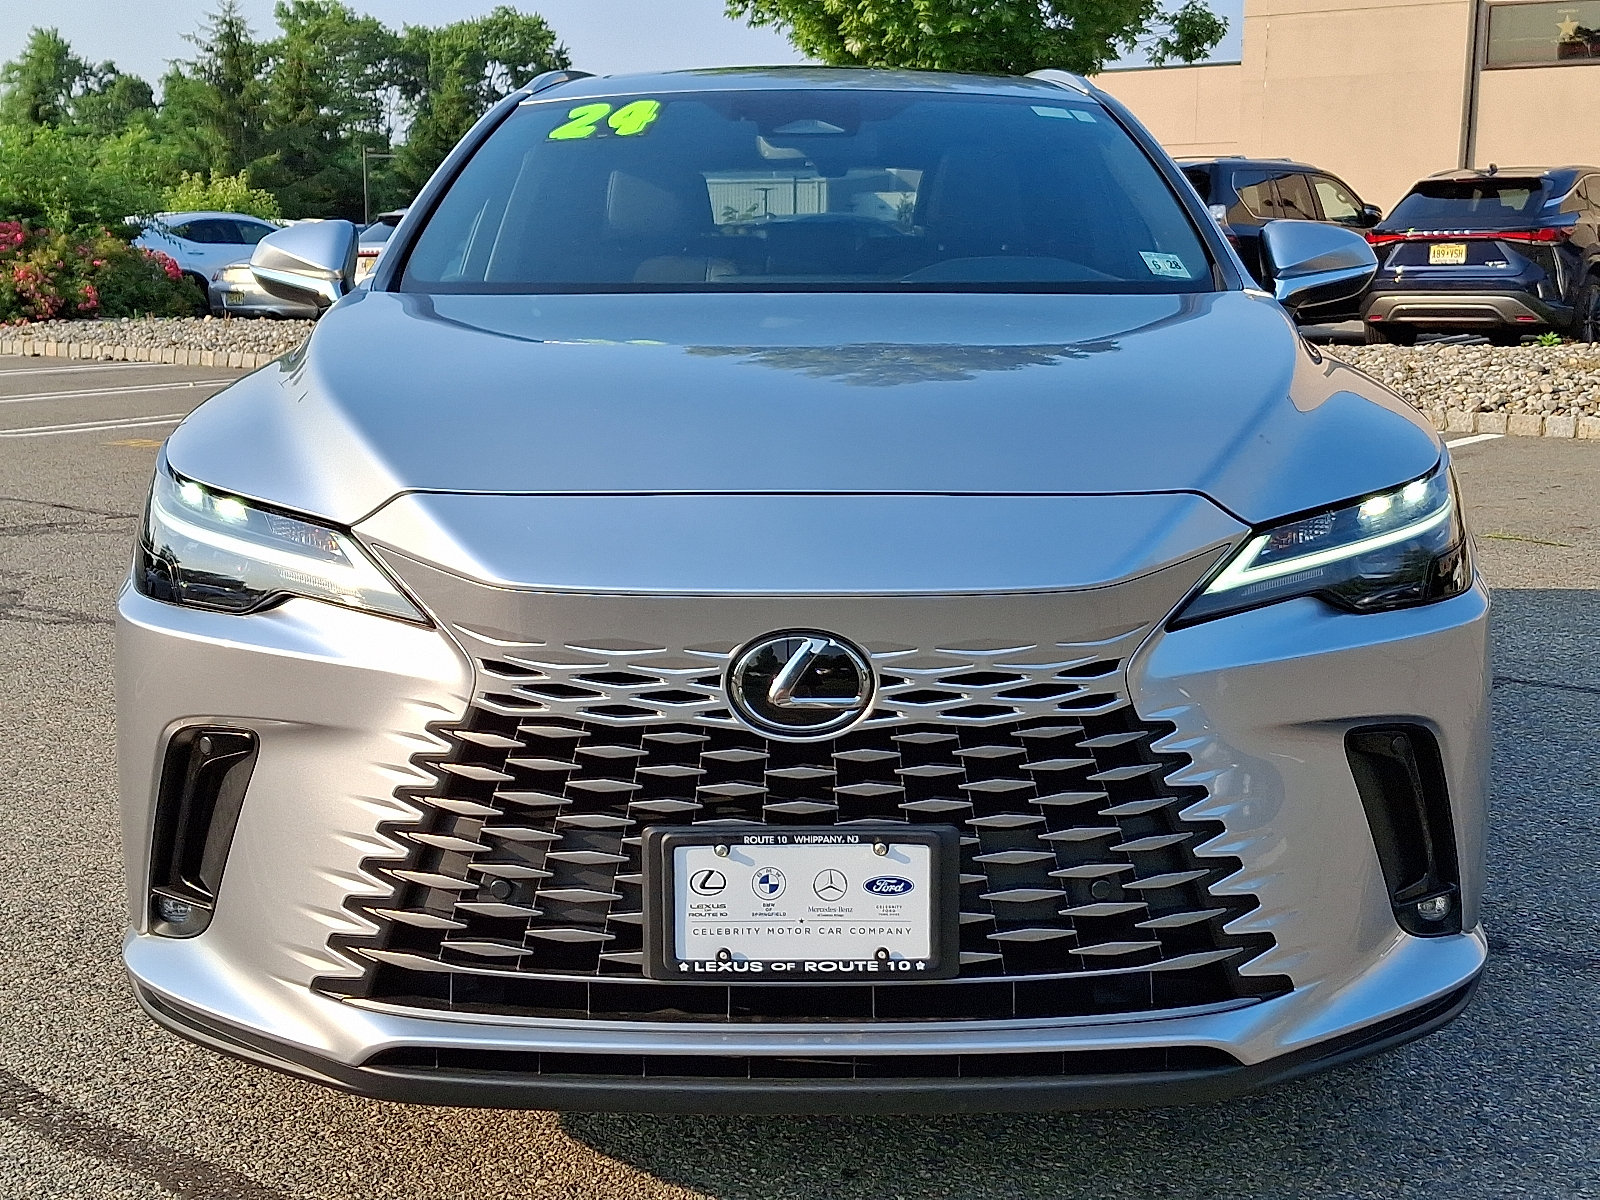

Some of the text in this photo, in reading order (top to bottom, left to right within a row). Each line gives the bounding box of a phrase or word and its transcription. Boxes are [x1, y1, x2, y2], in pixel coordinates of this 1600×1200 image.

[549, 101, 660, 139] 24
[1152, 260, 1182, 270] 6 28
[743, 835, 860, 844] ROUTE 10 WHIPPANY, NJ
[872, 879, 905, 893] Ford
[692, 927, 912, 936] CELEBRITY MOTOR CAR COMPANY
[694, 961, 911, 972] LEXUS OF ROUTE 10
